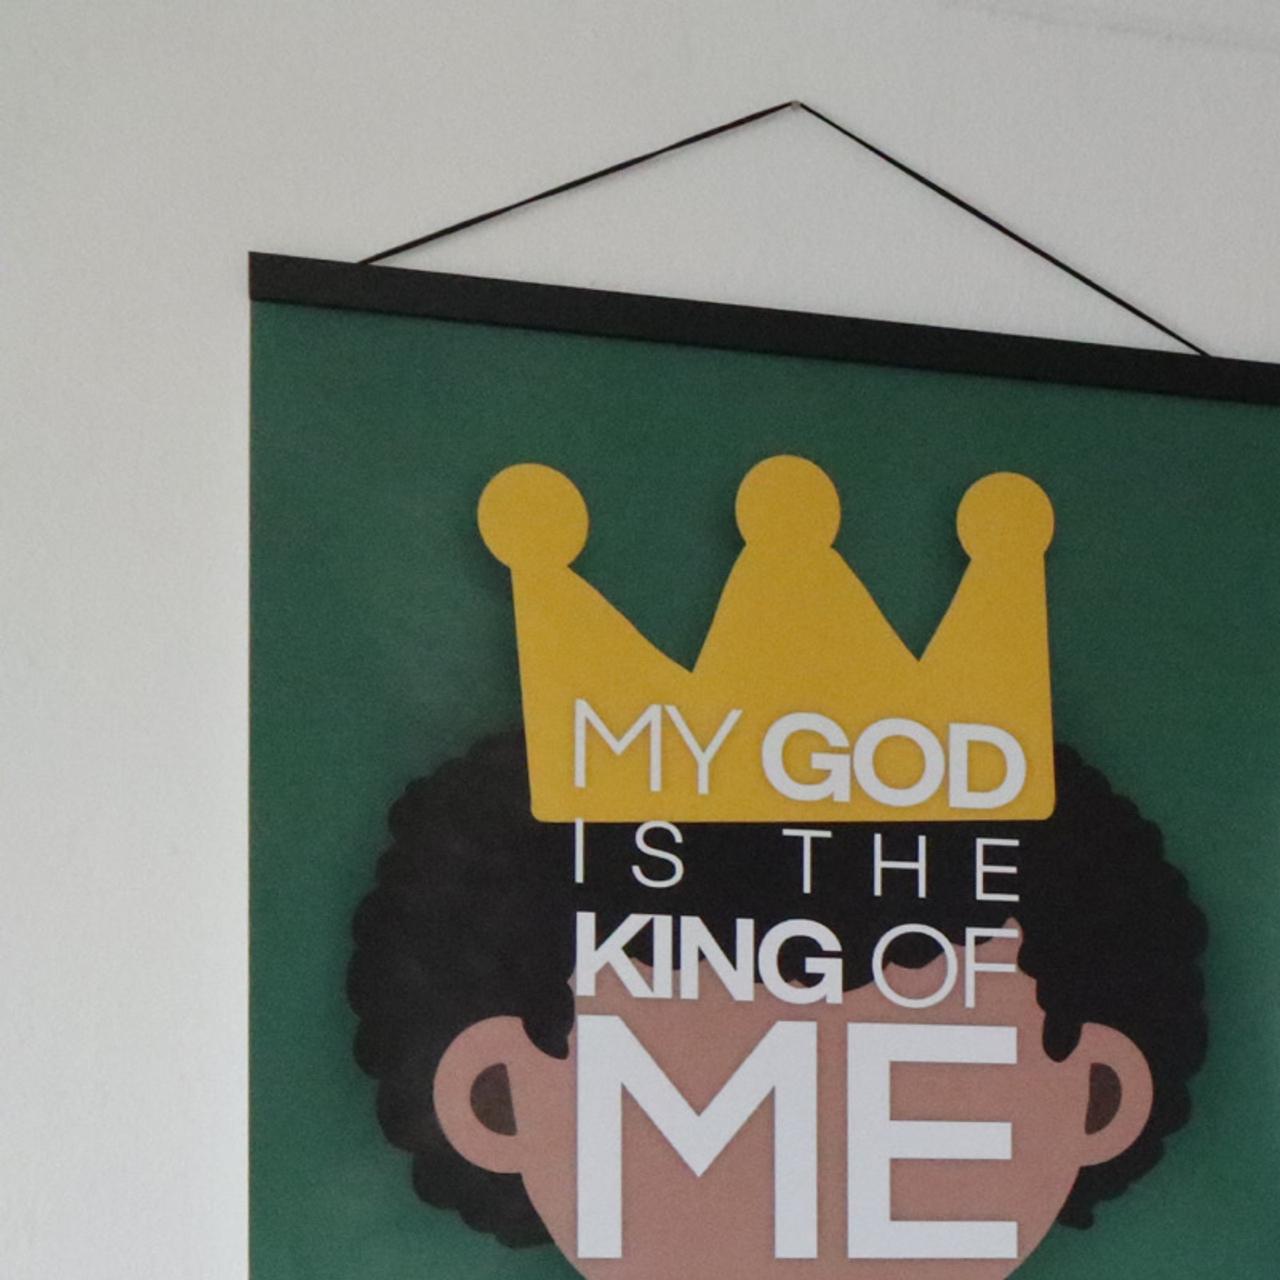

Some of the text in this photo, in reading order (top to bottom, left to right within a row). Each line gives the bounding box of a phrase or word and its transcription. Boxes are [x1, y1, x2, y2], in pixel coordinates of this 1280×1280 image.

[573, 698, 1028, 810] MY GOD
[573, 817, 1021, 903] IS THE
[574, 910, 1021, 1009] KING OF
[576, 1013, 1019, 1260] ME
